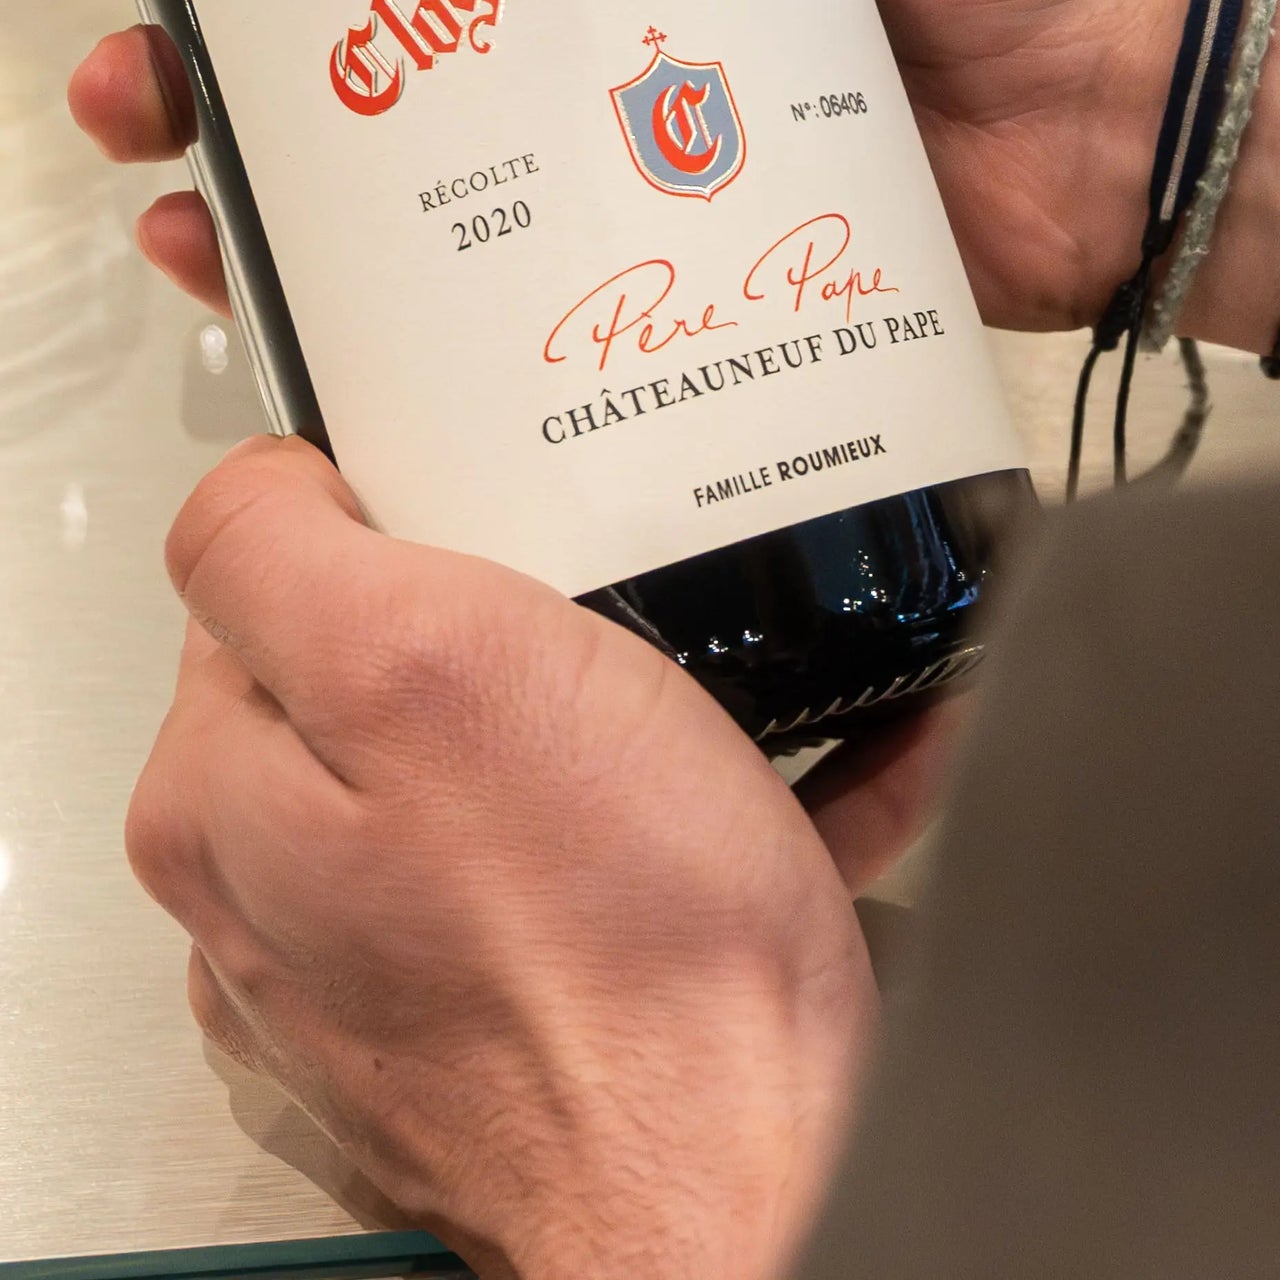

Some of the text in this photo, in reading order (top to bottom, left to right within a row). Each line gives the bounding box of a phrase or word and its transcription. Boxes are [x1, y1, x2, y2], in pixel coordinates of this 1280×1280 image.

[418, 153, 540, 213] RÉCOLTE
[451, 200, 531, 252] 2020
[543, 213, 900, 372] Père Pape
[542, 308, 946, 444] CHÂTEAUNEUF DU PAPE
[693, 434, 888, 508] FAMILLE ROUMIEUX
